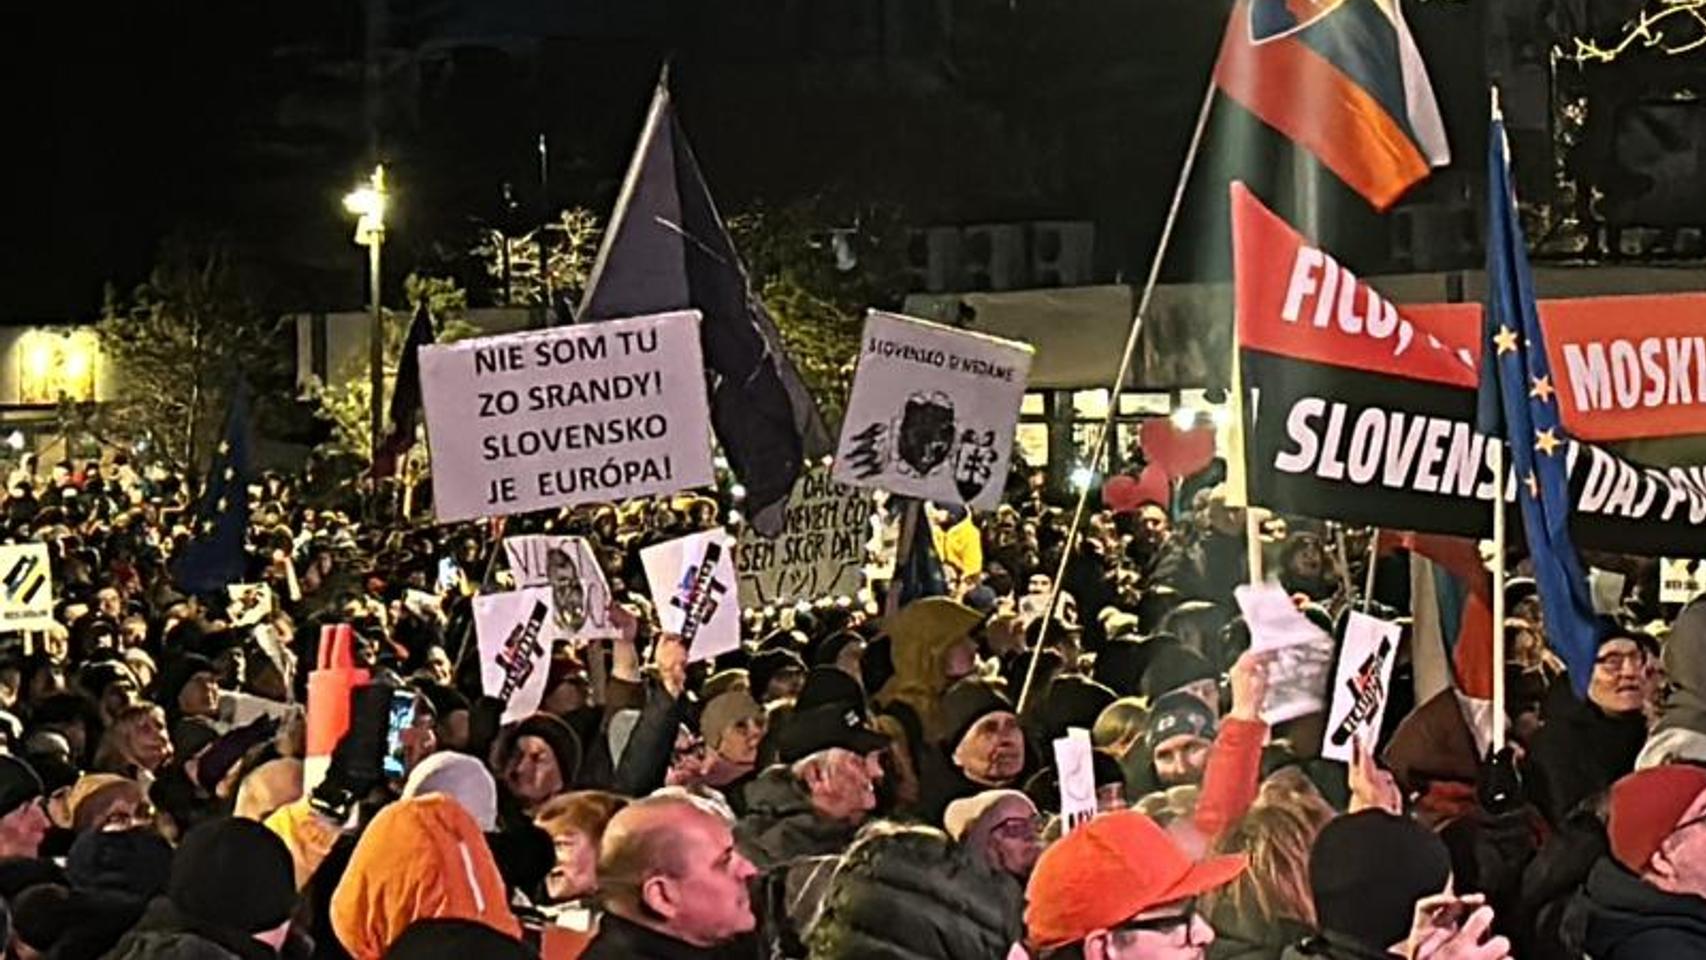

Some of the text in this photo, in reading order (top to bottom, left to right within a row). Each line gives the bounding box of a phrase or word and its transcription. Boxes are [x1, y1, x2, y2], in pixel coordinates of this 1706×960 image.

[475, 328, 658, 376] NIE SOM TU
[478, 371, 662, 418] ZO SRANDY!
[483, 415, 668, 461] SLOVENSKO
[1274, 397, 1578, 503] SLOVENS
[1577, 444, 1657, 519] DAJ
[488, 456, 672, 505] JE EURÓPA!
